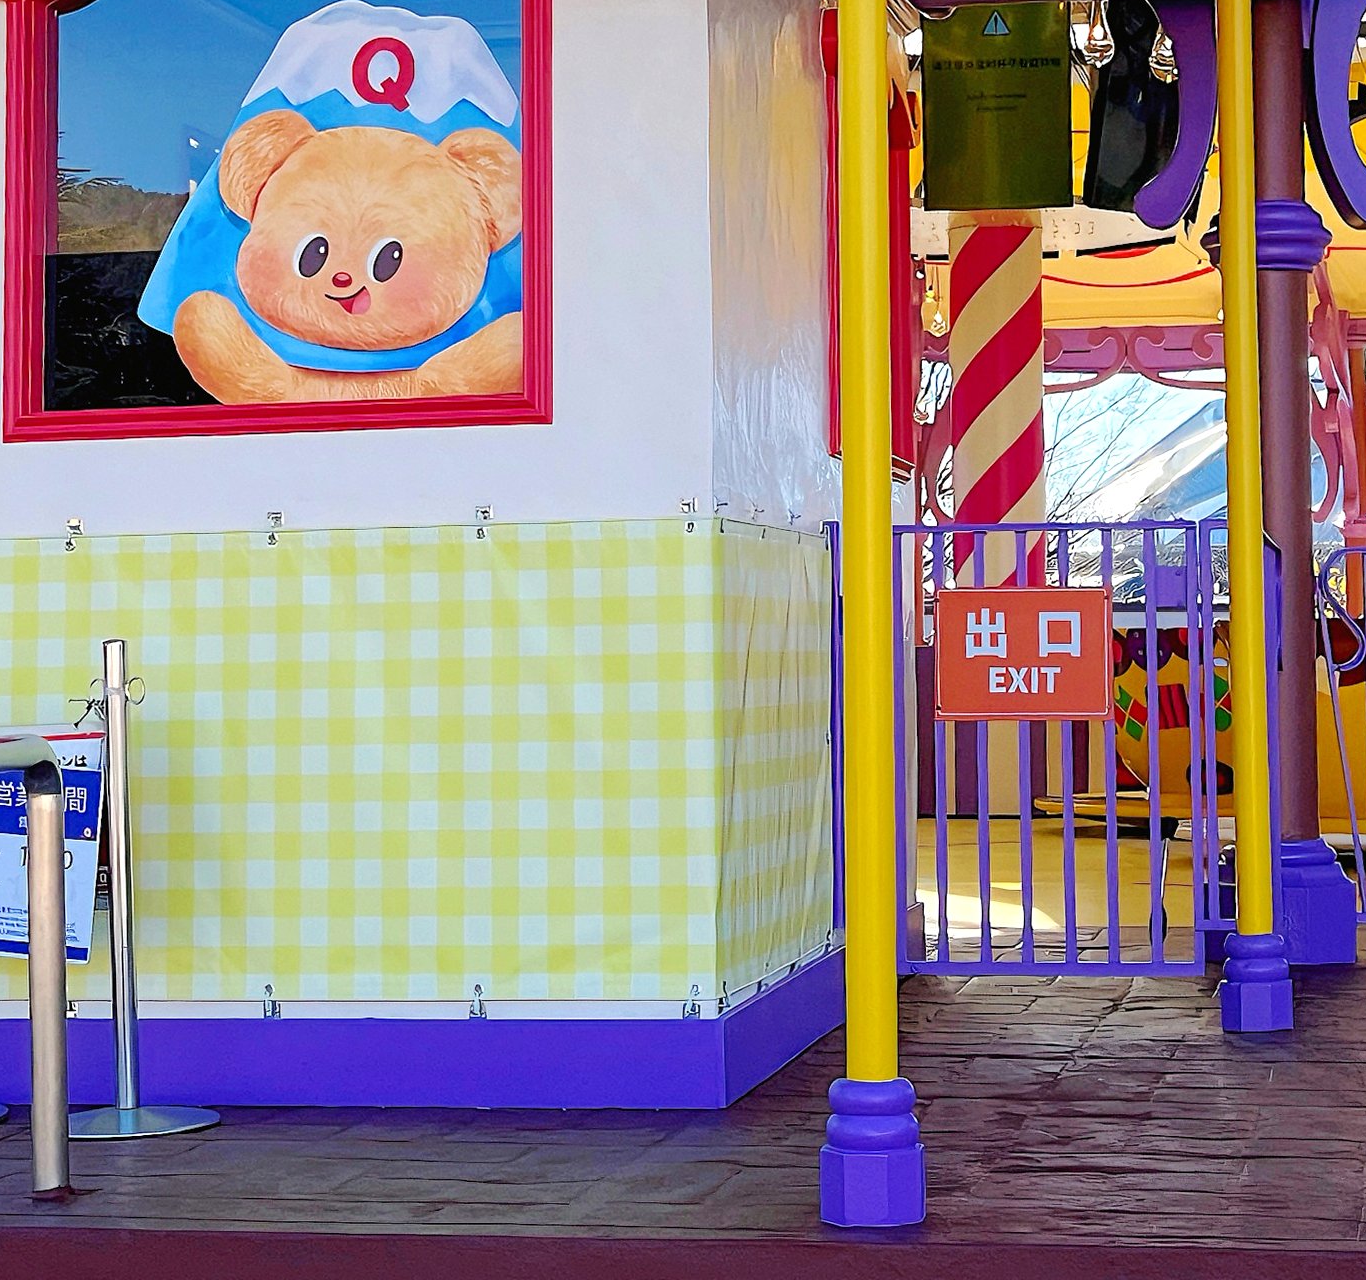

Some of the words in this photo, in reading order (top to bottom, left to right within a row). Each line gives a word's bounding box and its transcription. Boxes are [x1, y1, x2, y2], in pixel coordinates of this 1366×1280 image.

[351, 36, 415, 113] Q
[965, 607, 1081, 659] 出口
[988, 666, 1062, 694] EXIT
